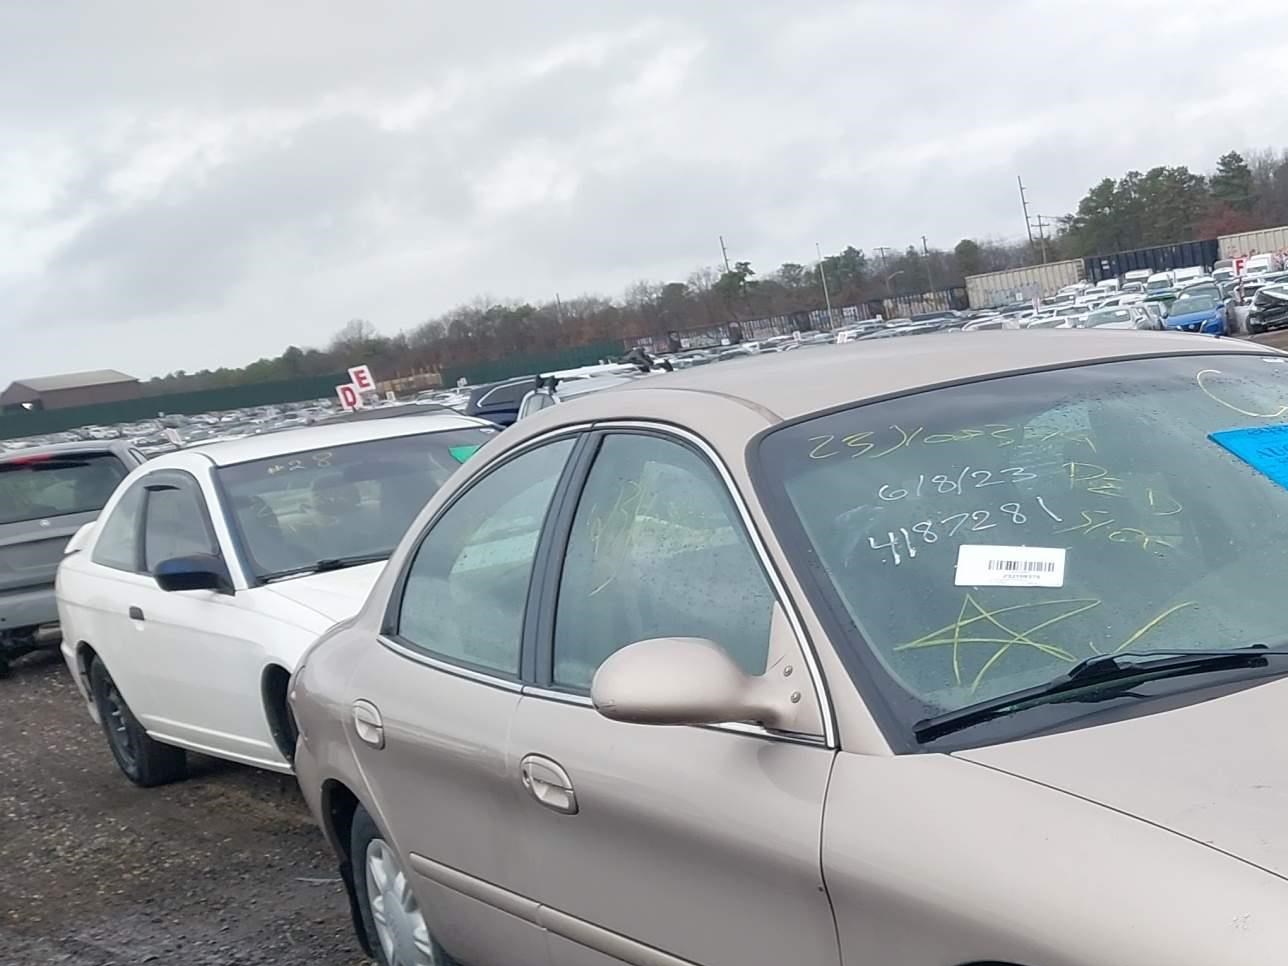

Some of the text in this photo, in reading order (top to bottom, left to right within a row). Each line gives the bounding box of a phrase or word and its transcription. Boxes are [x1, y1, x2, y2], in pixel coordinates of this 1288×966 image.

[1235, 259, 1246, 274] F
[353, 369, 370, 388] E
[340, 386, 357, 408] D
[867, 496, 1064, 565] 4187281
